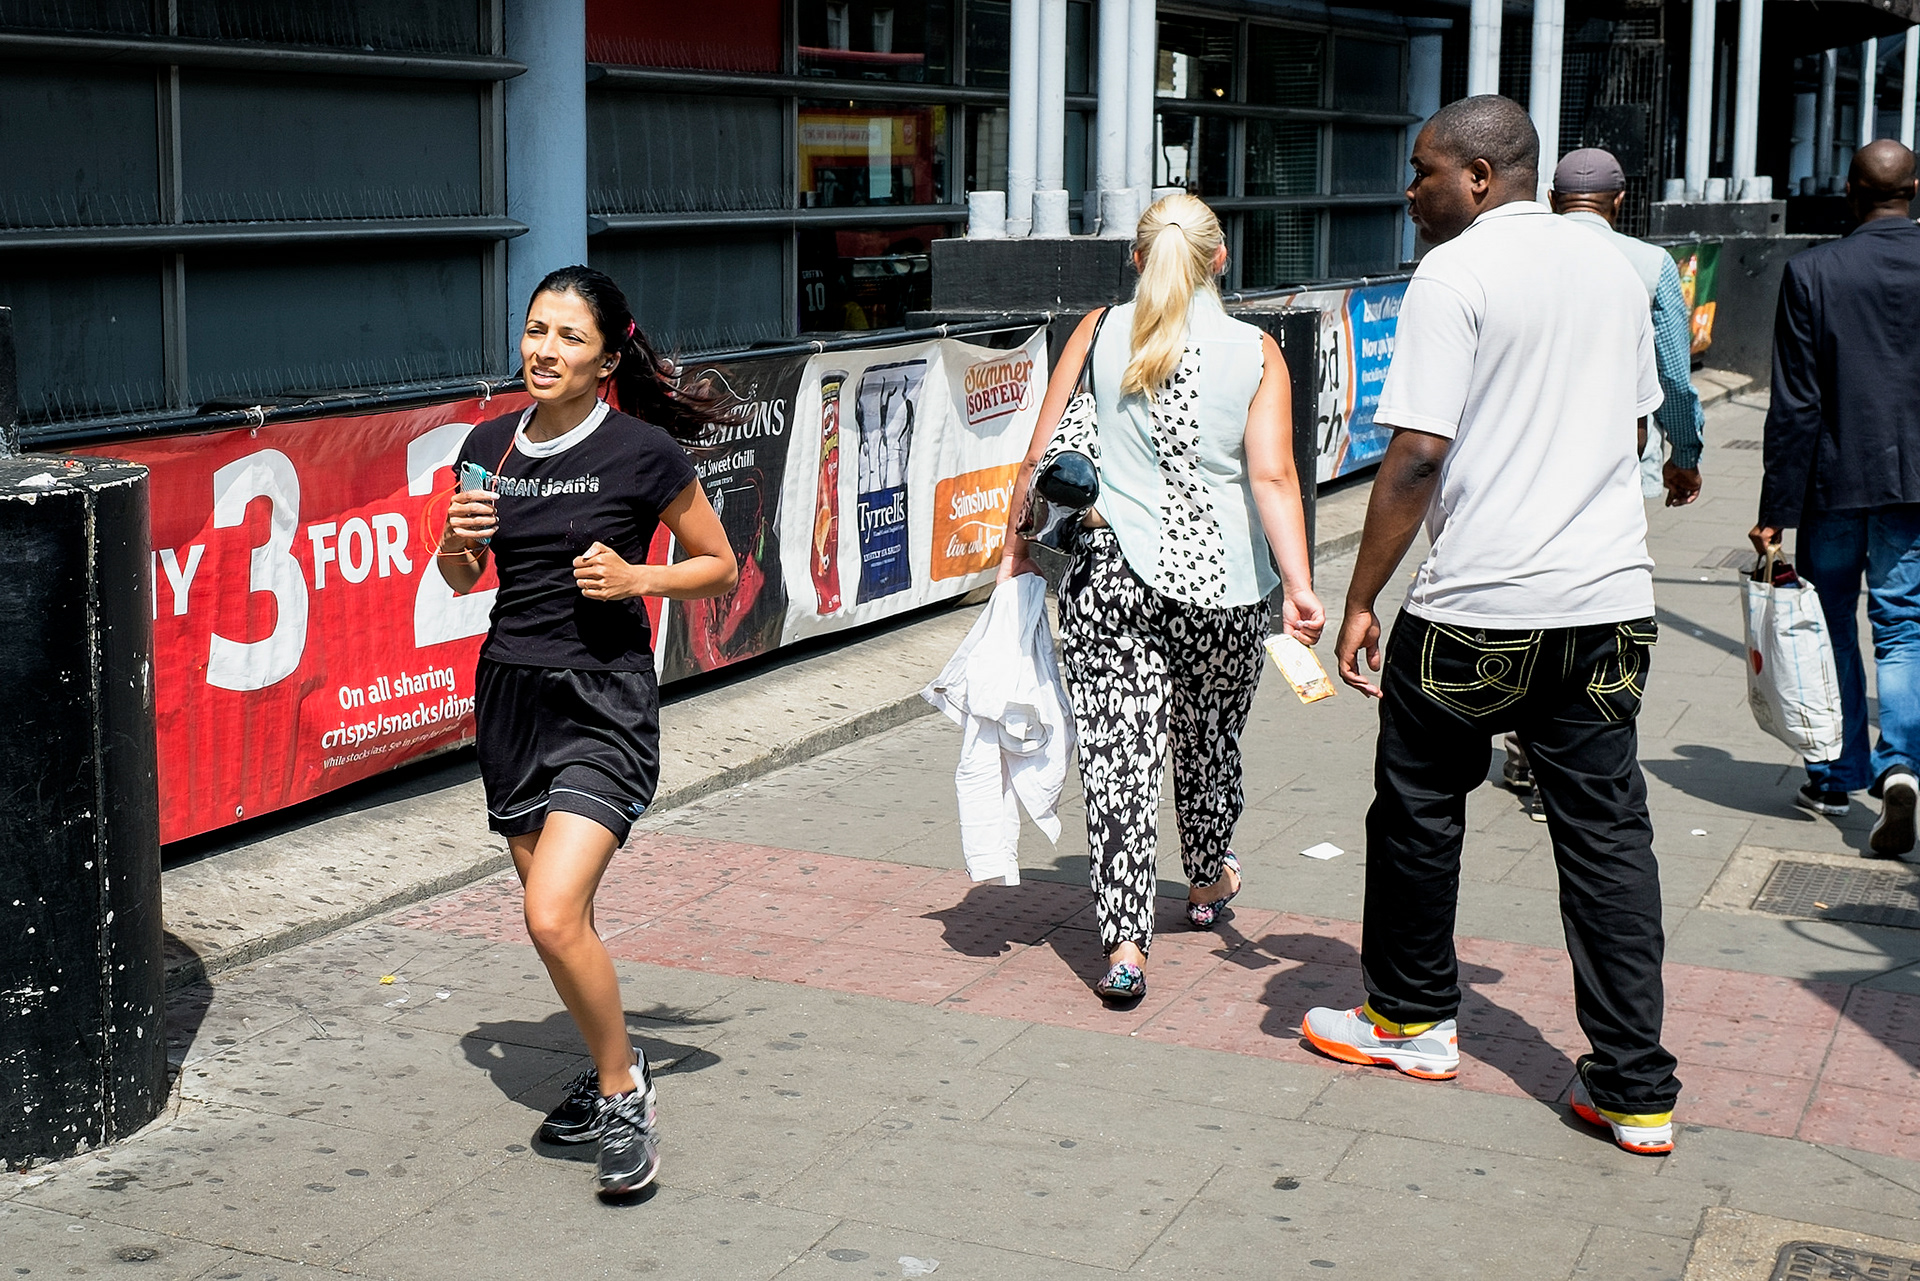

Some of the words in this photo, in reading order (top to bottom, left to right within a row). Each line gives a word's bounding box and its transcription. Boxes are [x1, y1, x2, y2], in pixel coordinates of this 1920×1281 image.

[805, 282, 826, 311] 10
[964, 359, 1034, 395] Summer
[968, 381, 1023, 416] SORTED
[707, 455, 731, 476] Sweet
[732, 449, 755, 470] Chilli
[858, 491, 906, 544] Tyrrell's
[205, 448, 309, 692] 3
[307, 512, 413, 590] FOR
[338, 685, 365, 710] On
[367, 675, 392, 705] all
[393, 665, 455, 699] sharing
[321, 694, 475, 749] crisps/snacks/dips
[323, 753, 346, 769] While
[345, 748, 371, 763] stocks
